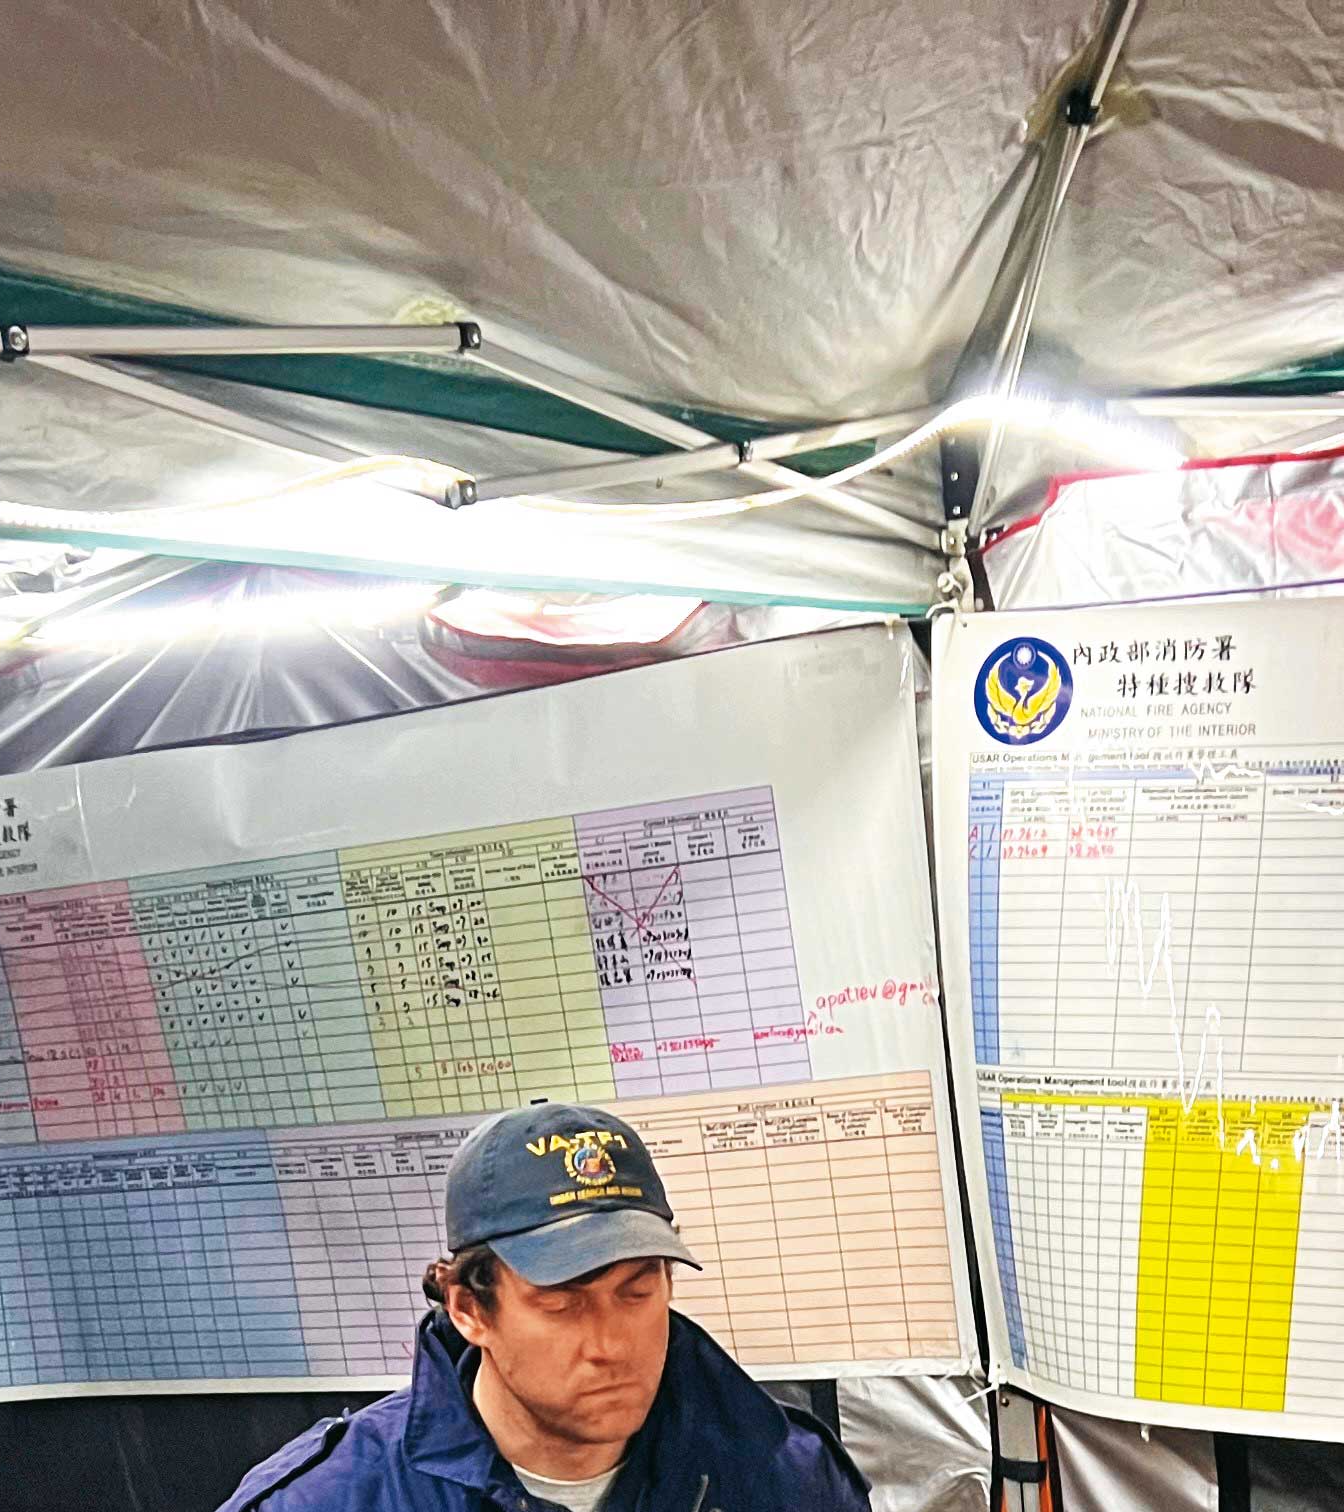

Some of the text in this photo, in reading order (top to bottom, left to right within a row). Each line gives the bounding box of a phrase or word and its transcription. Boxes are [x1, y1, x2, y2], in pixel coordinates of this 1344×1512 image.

[1073, 635, 1237, 665] 內政部消防署
[1117, 667, 1257, 698] 特種搜救隊
[1080, 701, 1233, 719] NATIONAL FIRE AGENCY
[1088, 723, 1257, 741] MINISTRY OF THE INTERIOR
[1043, 1075, 1105, 1088] Management
